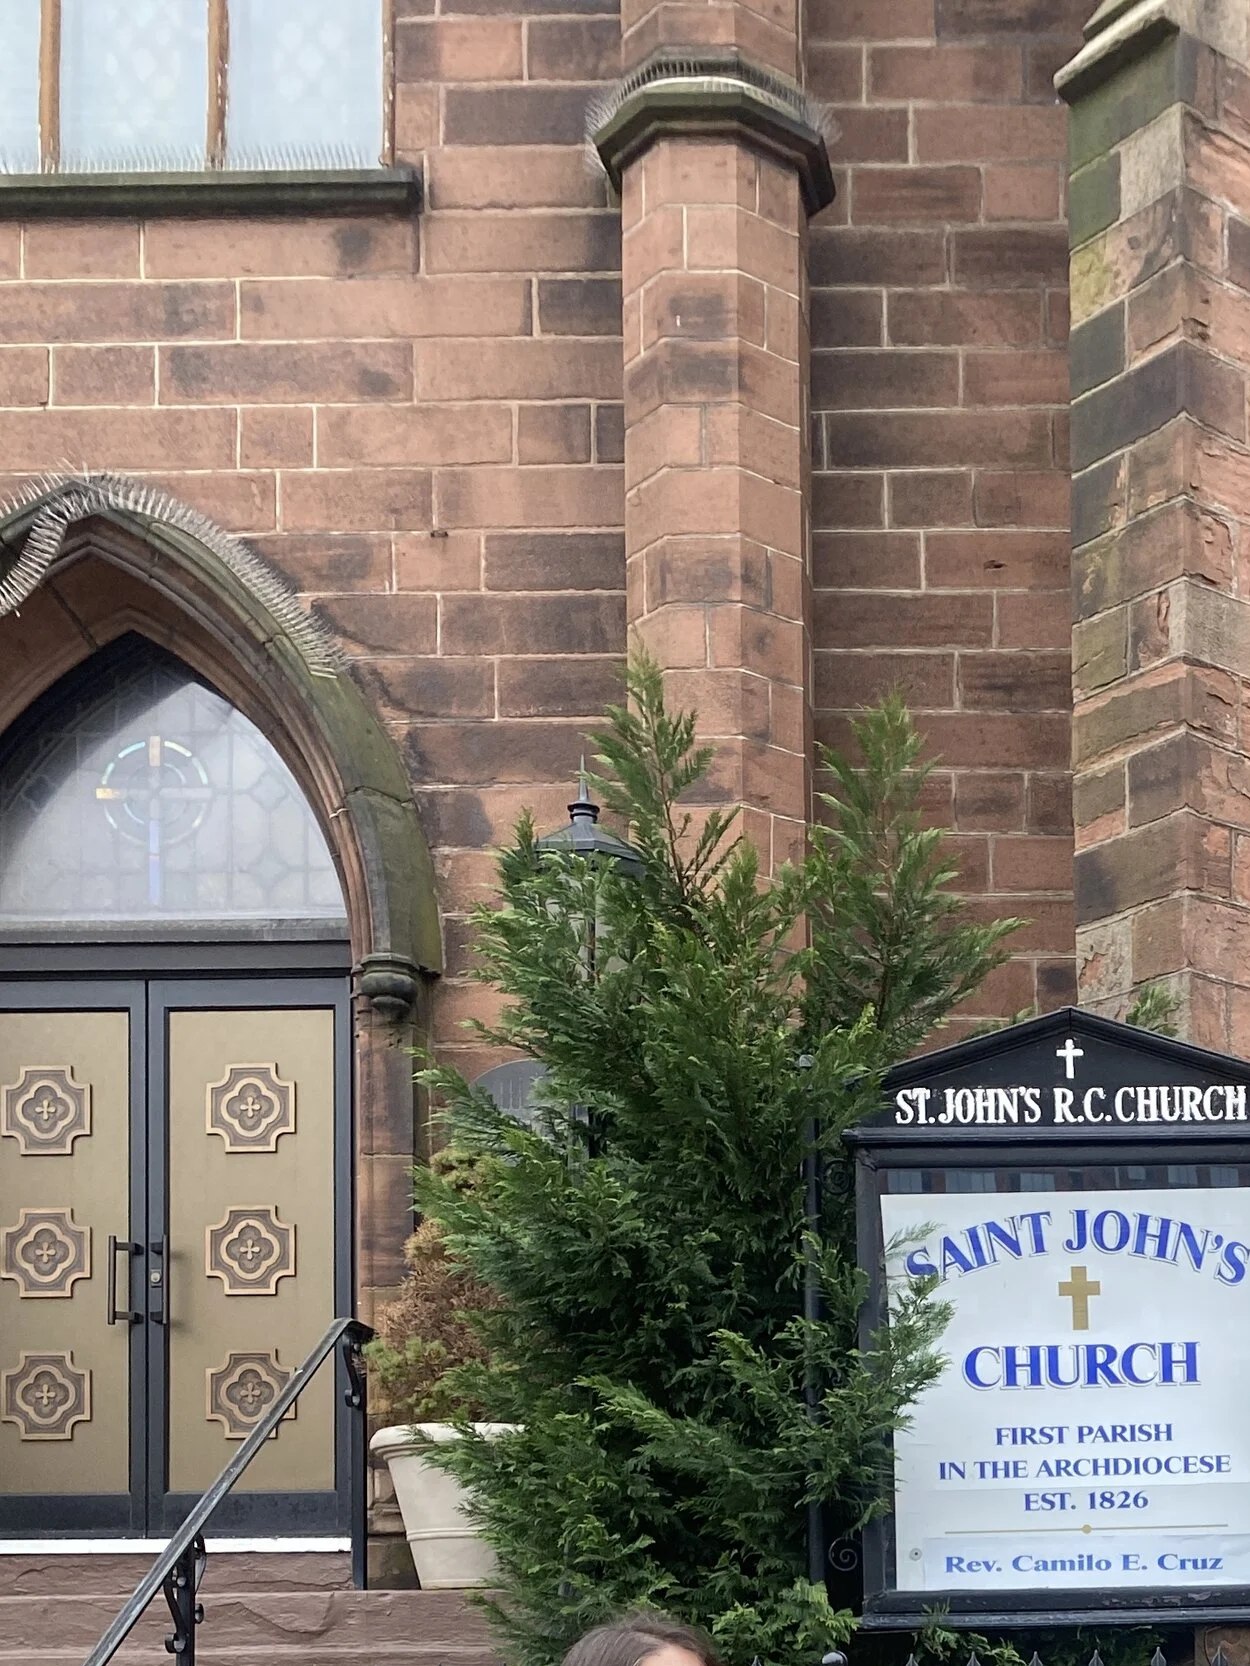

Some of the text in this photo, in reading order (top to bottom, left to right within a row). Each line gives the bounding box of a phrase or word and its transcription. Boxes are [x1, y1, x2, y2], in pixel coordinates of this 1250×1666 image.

[904, 1210, 1052, 1283] SAINT
[963, 1341, 1201, 1391] CHURCH
[996, 1424, 1173, 1446] FIRST PARISH
[939, 1455, 1231, 1480] IN THE ARCHDIOCESE
[1024, 1490, 1149, 1512] EST. 1826
[945, 1553, 1224, 1574] Rev. Camilo E. Cruz
